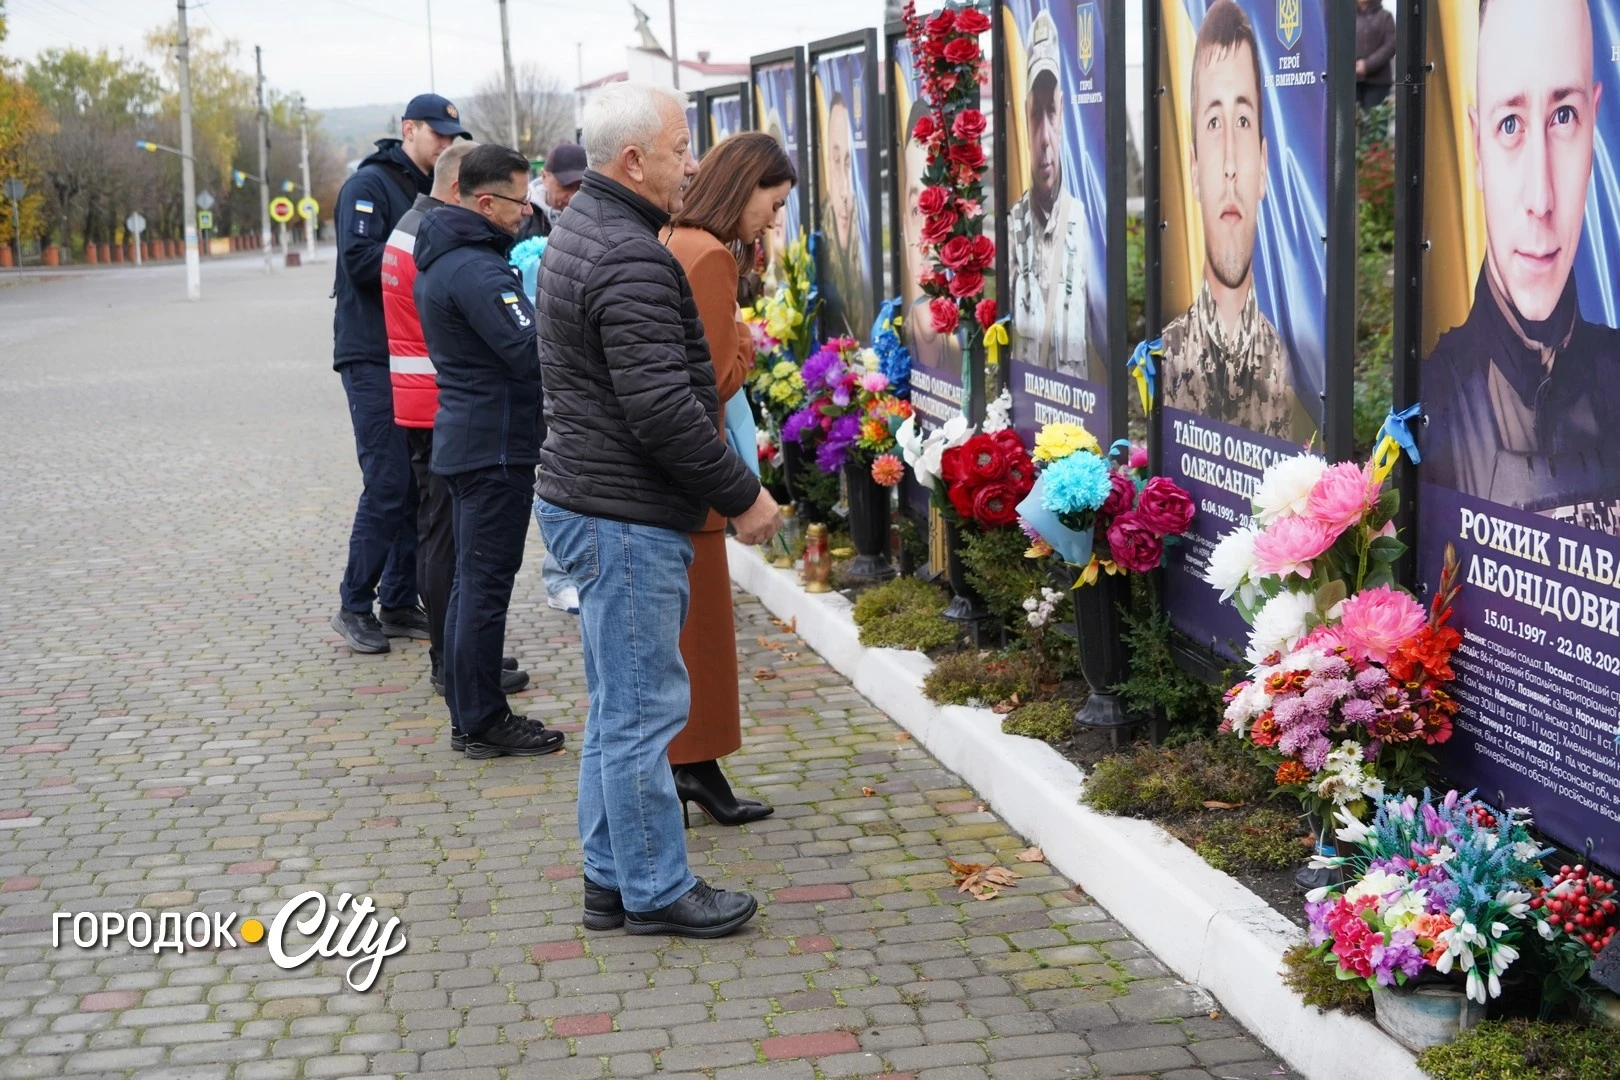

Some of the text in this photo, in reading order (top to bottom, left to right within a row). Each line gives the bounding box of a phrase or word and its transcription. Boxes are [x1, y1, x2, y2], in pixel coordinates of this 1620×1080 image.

[1275, 71, 1316, 86] ВМИРАЮТЬ
[1278, 52, 1300, 70] ГЕРОЇ
[1024, 372, 1096, 414] ШАРАМКО ІГОР
[1174, 420, 1221, 456] ТАЇПОВ
[1201, 498, 1234, 522] 6.04.1992
[1460, 508, 1550, 566] РОЖИК
[1466, 554, 1620, 637] ЛЕОНІДОВИ
[1484, 608, 1546, 646] 15.01.1997
[1557, 636, 1620, 676] 22.08.202
[1480, 650, 1494, 666] 86-й
[1494, 658, 1523, 679] окремий
[1525, 669, 1561, 695] батальйон
[1562, 686, 1618, 719] територіальної
[1487, 640, 1516, 659] старший
[1518, 652, 1543, 670] солдат.
[1545, 661, 1574, 684] Посада:
[1575, 676, 1609, 698] старший
[1504, 723, 1513, 738] 22
[1538, 739, 1554, 758] 2023
[1577, 760, 1591, 776] час
[1570, 721, 1588, 740] ЗОШ
[1548, 761, 1594, 794] Херсонської
